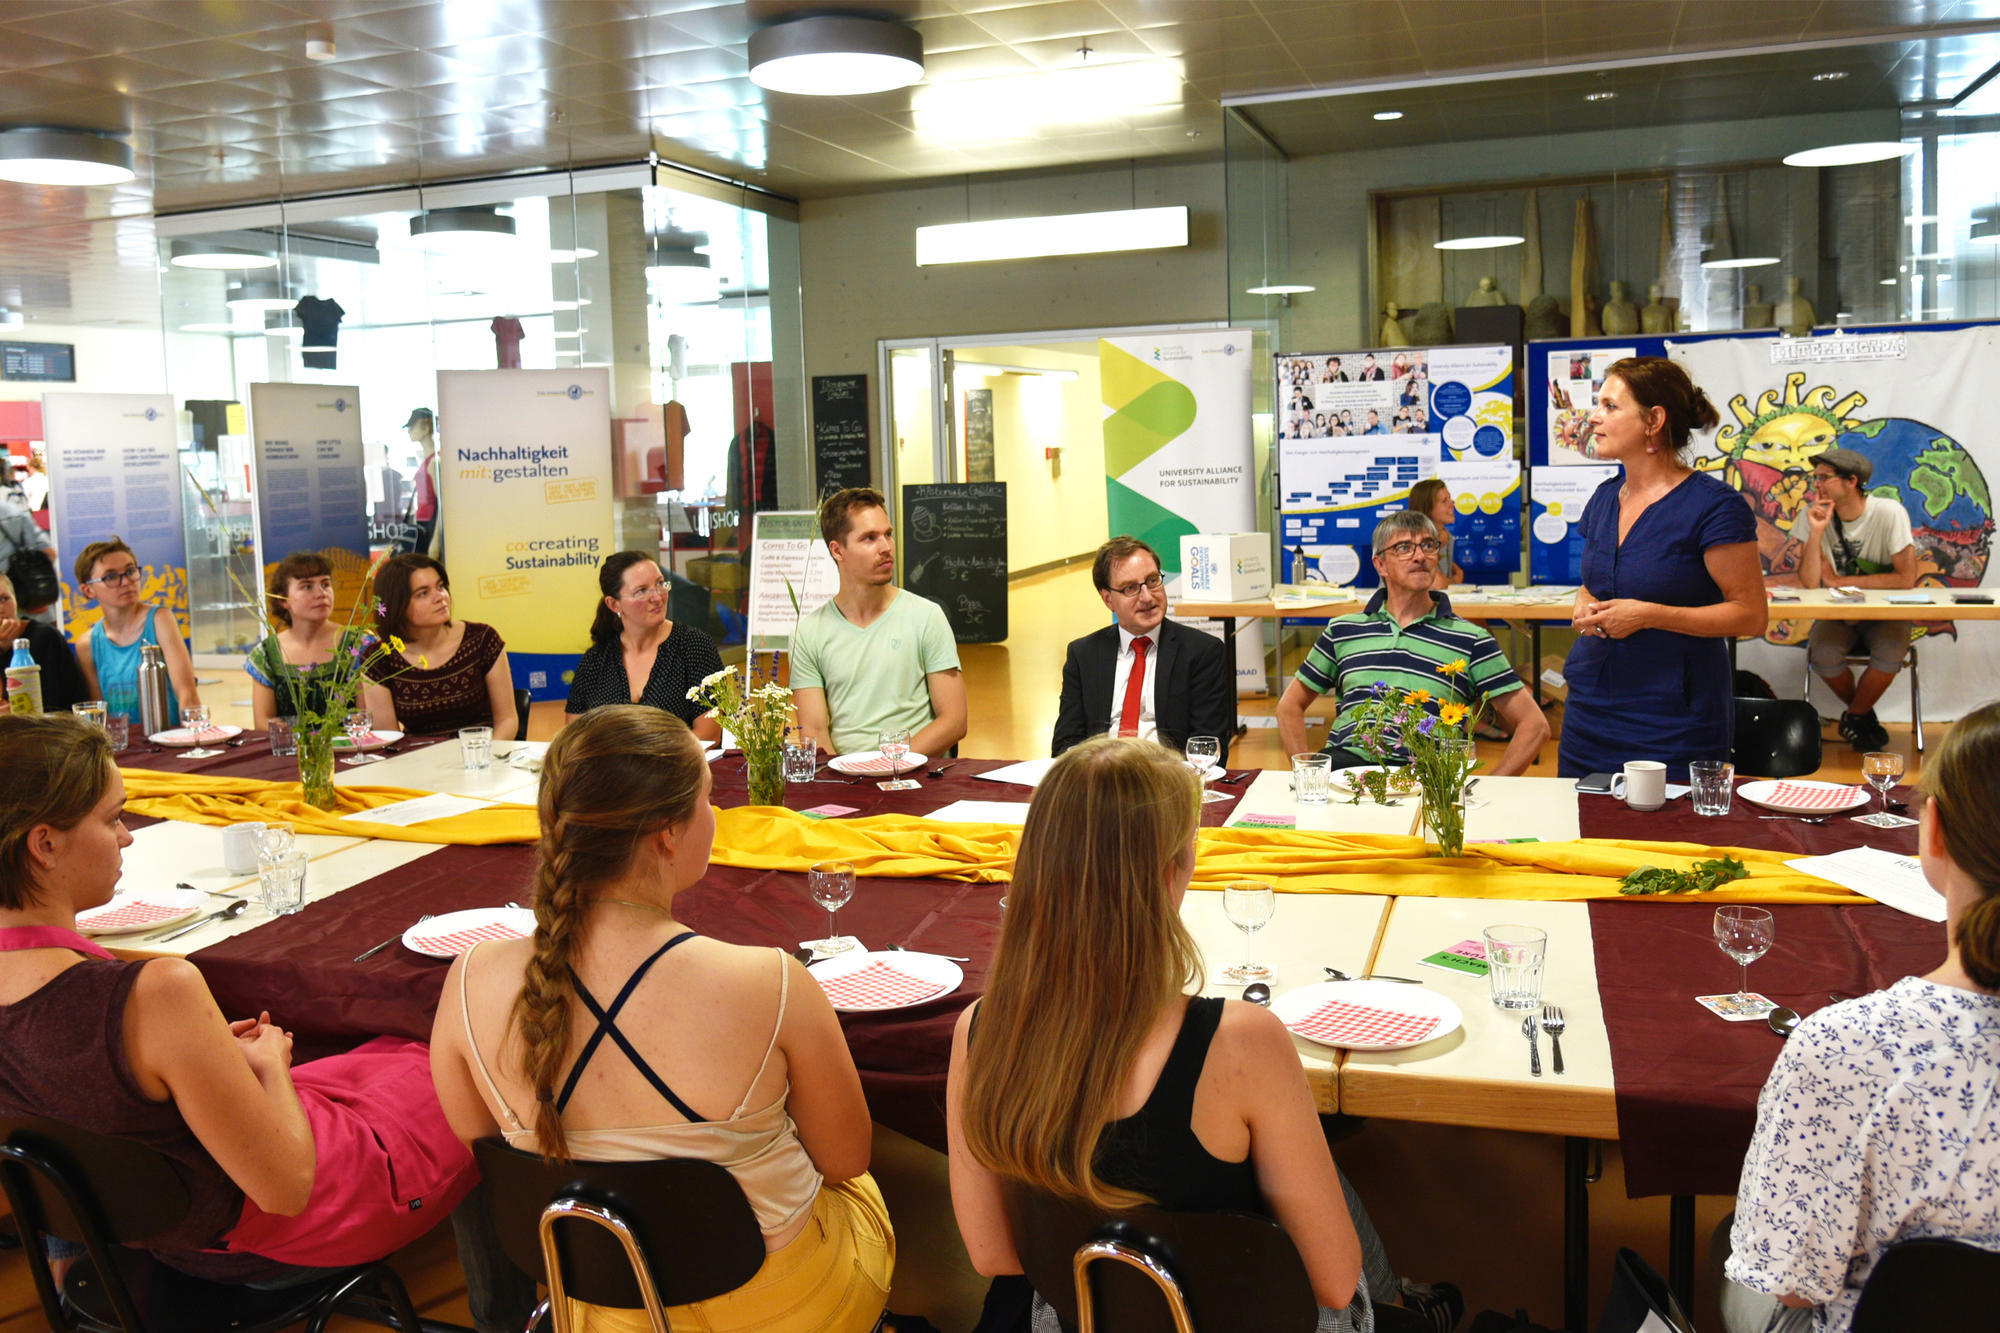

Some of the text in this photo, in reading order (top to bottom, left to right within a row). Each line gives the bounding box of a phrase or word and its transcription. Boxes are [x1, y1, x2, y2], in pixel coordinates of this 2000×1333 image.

[458, 445, 568, 464] Nachhaltigkeit
[1159, 465, 1243, 477] UNIVERSITY ALLIANCE
[1177, 477, 1239, 487] SUSTAINABILITY
[506, 552, 600, 570] Sustainability
[1190, 546, 1200, 590] GOALS
